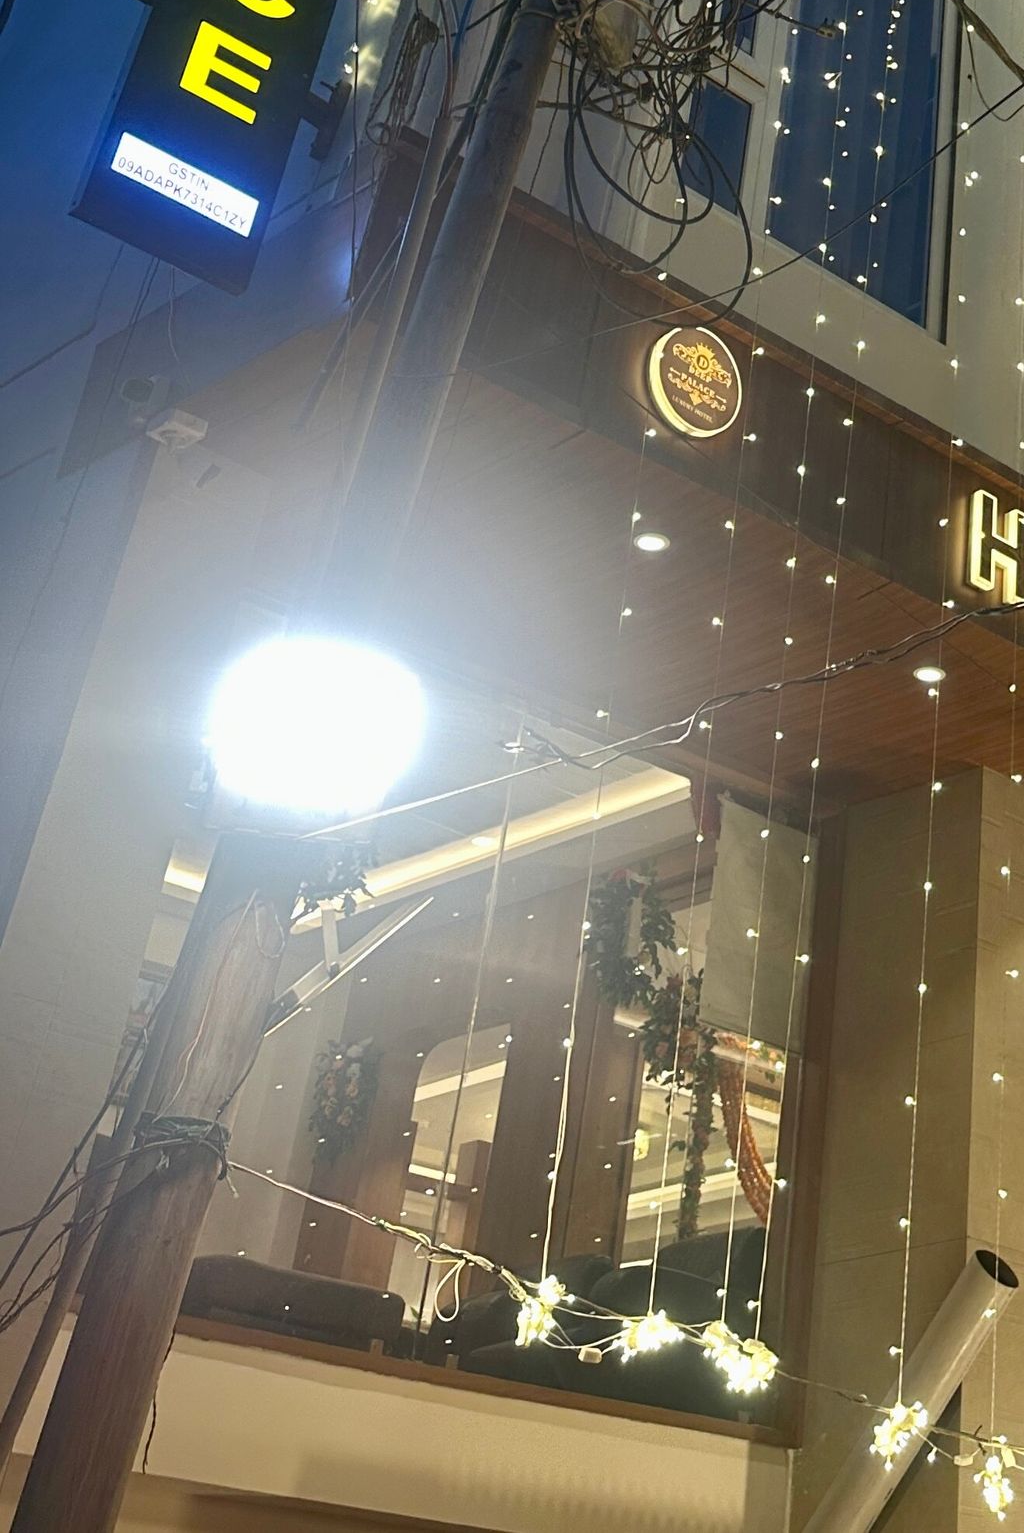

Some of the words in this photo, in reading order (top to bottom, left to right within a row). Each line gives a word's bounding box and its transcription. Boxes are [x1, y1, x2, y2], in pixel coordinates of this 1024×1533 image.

[168, 162, 209, 191] GSTIN
[680, 372, 716, 398] PALACE
[688, 365, 713, 383] DEEP
[694, 408, 713, 423] HOTEL
